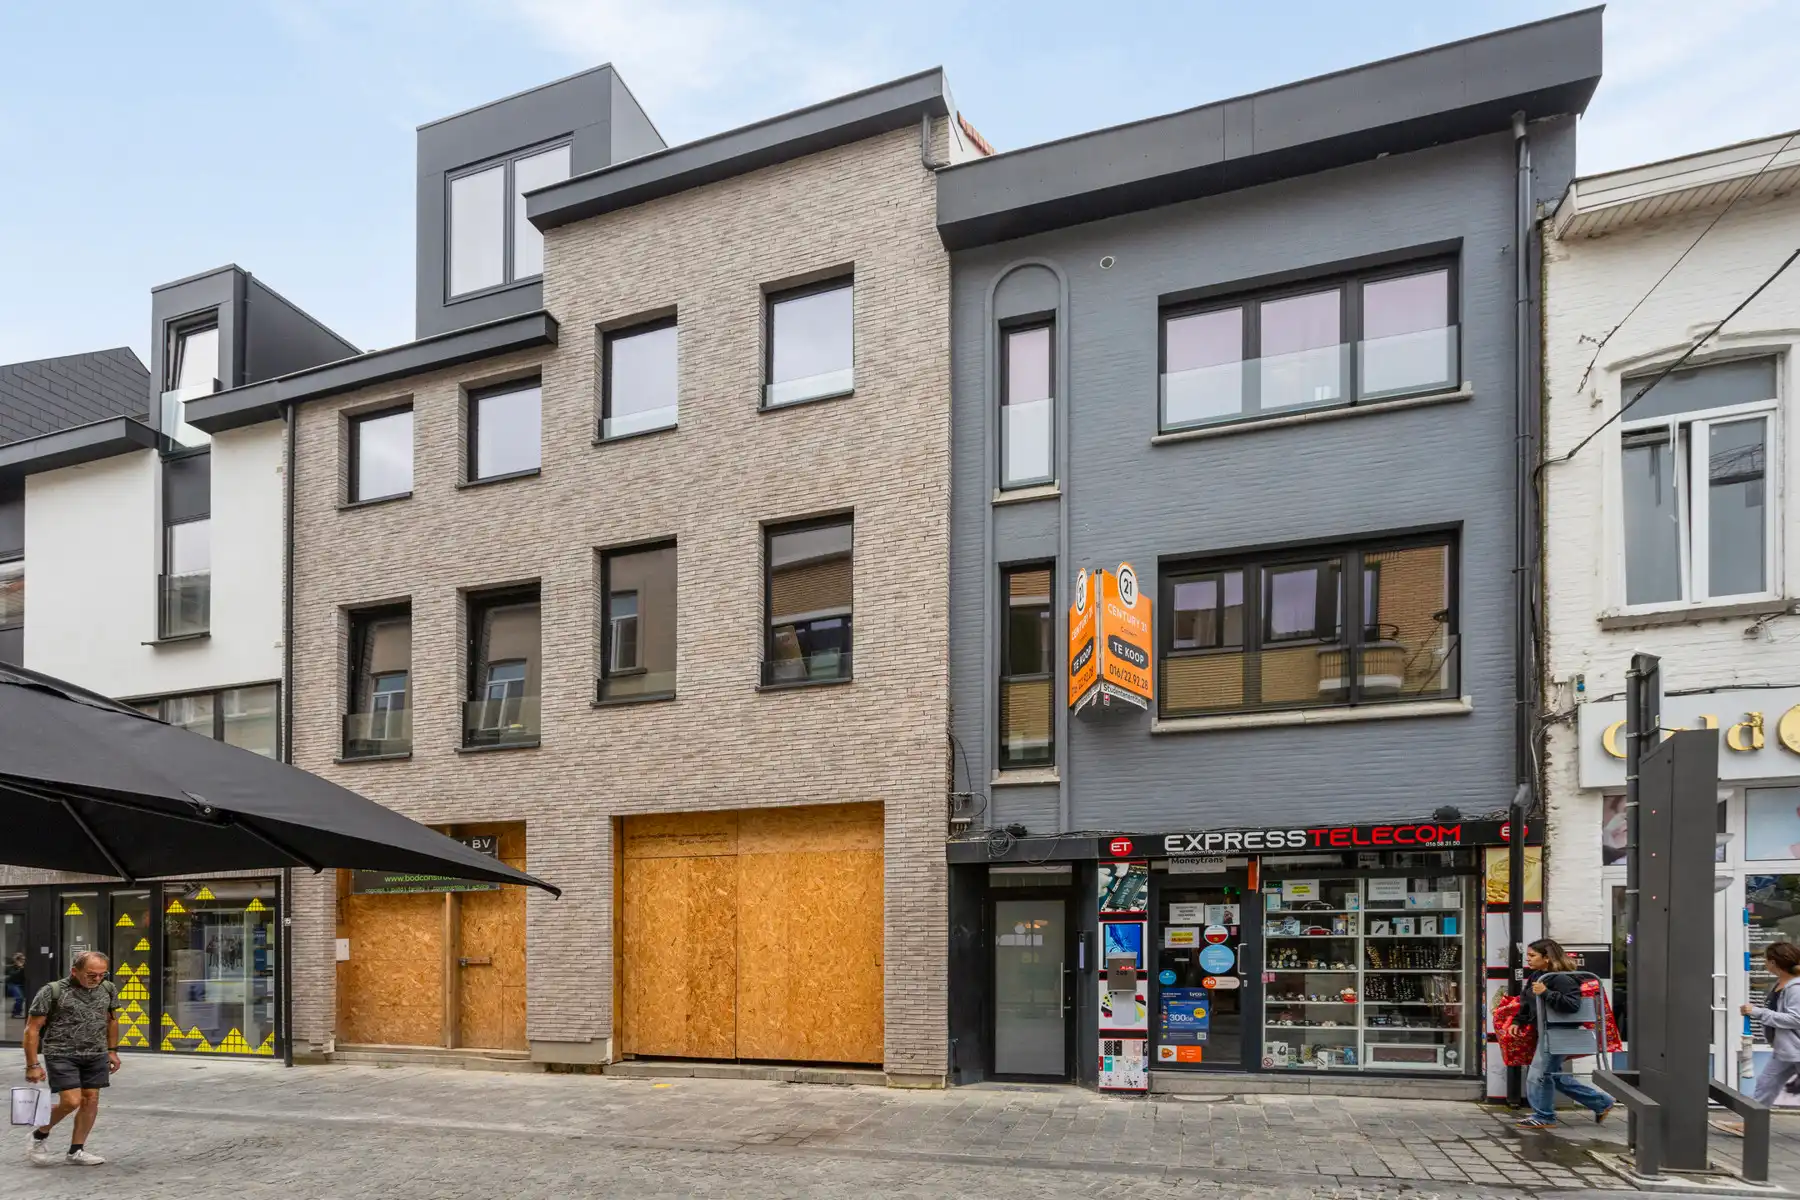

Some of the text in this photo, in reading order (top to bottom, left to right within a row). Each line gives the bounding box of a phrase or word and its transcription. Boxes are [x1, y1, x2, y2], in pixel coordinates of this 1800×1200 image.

[1124, 578, 1132, 596] 21
[1108, 603, 1140, 628] CENTURY
[1073, 660, 1079, 672] TE
[1079, 645, 1092, 666] KOOP
[1113, 641, 1144, 664] TE KOOP
[1109, 664, 1149, 690] 016/22.92.28
[472, 839, 491, 848] BV
[1111, 841, 1132, 852] ET
[1165, 824, 1461, 851] EXPRESS TELECOM
[1171, 856, 1224, 865] Moneytrans
